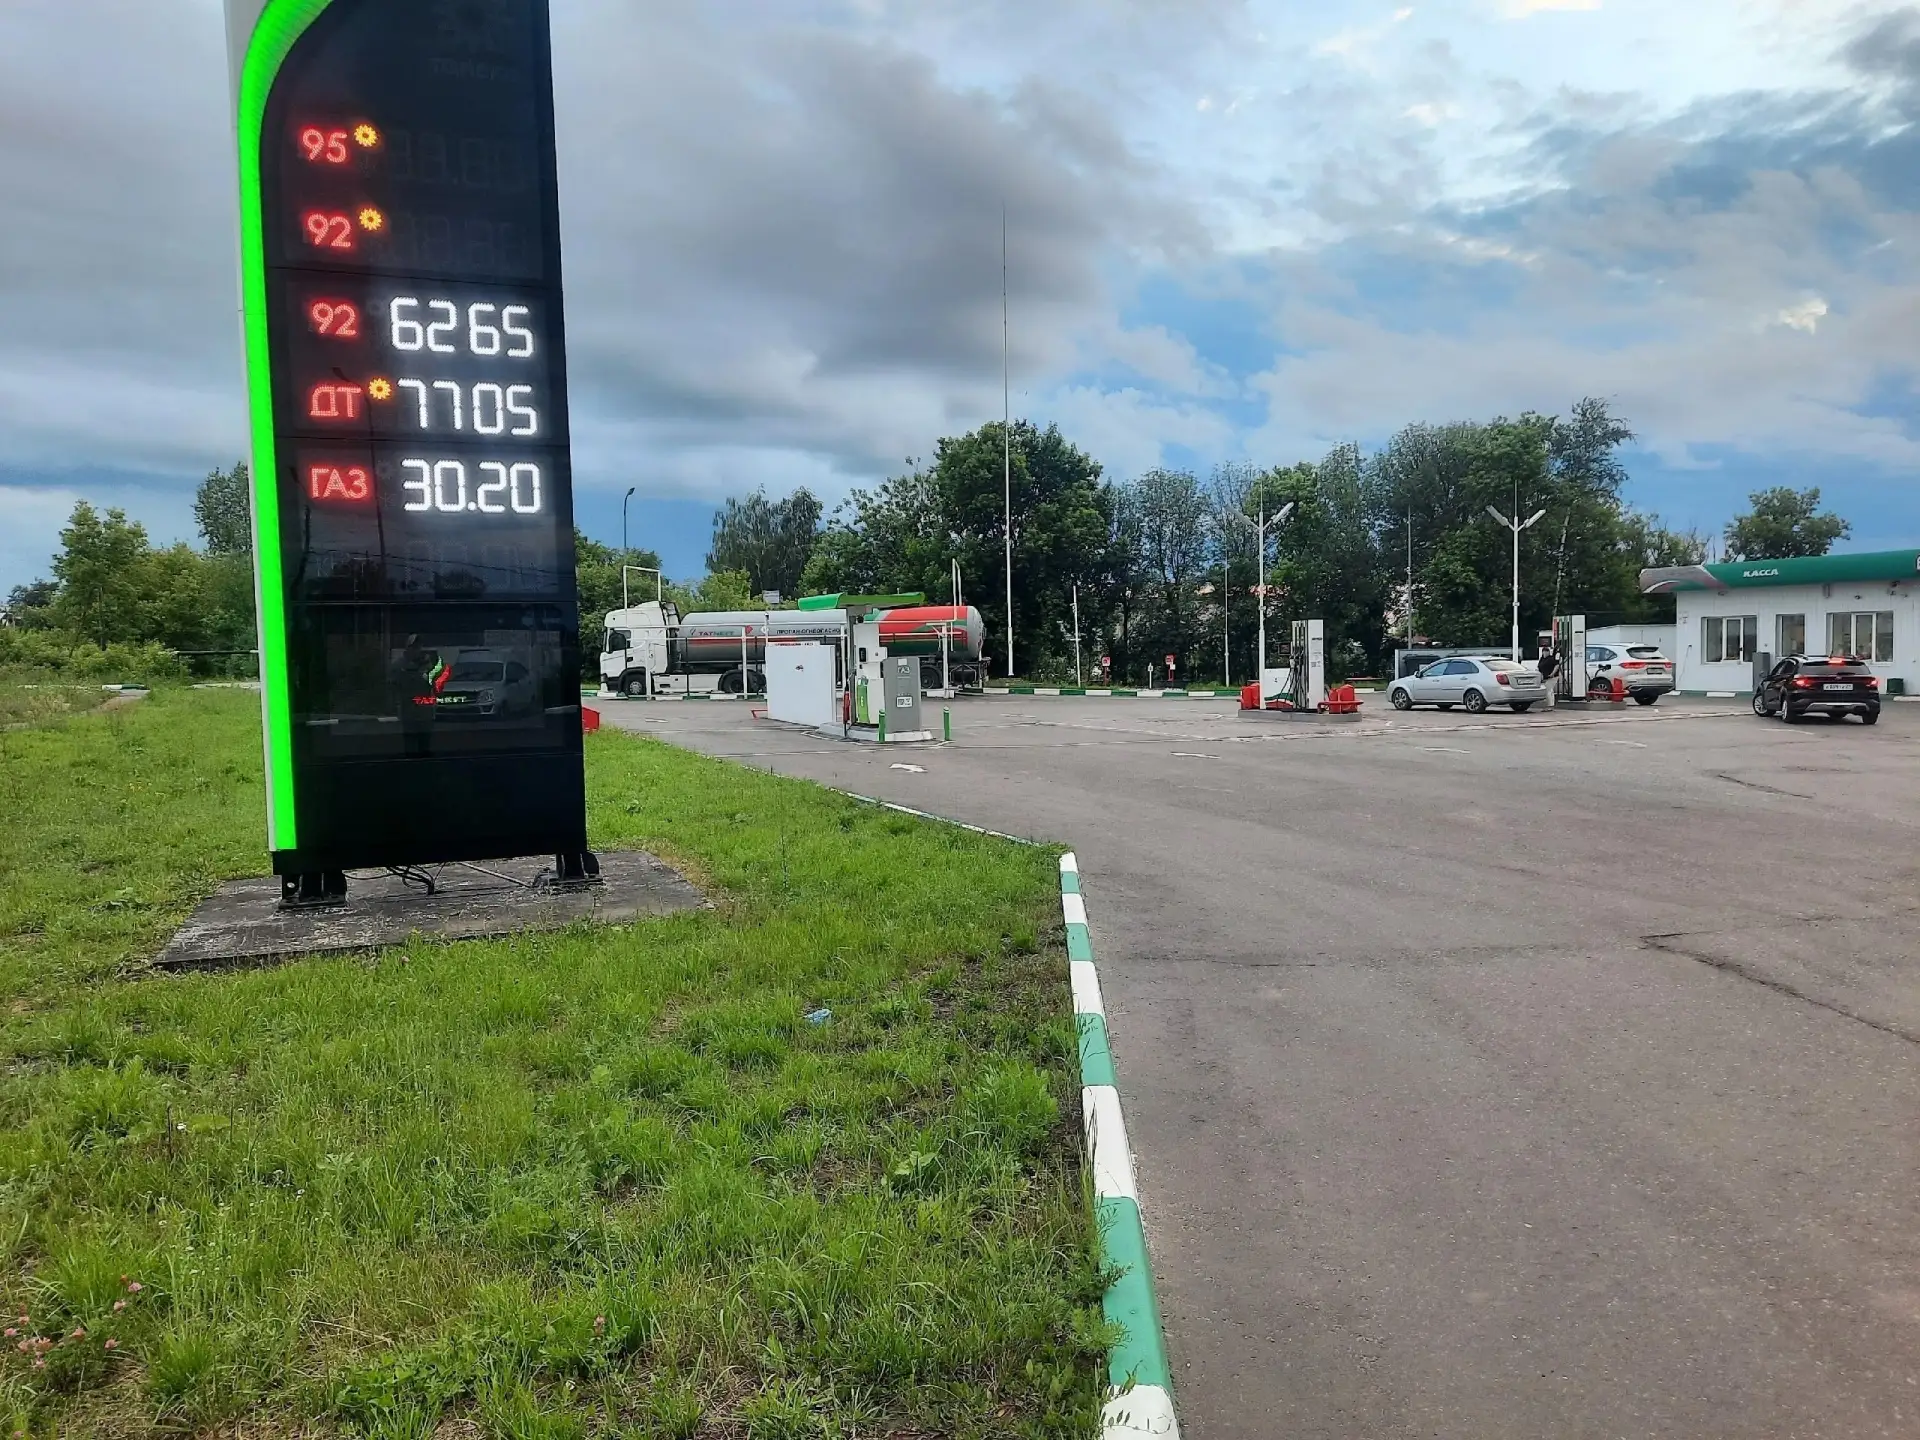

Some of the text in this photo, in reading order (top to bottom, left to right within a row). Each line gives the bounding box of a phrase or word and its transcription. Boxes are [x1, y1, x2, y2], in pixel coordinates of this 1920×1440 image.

[303, 128, 347, 163] 95
[308, 213, 351, 247] 92
[313, 302, 357, 335] 92
[310, 386, 362, 417] ДТ
[311, 458, 541, 513] ГАЗ 30.20
[1743, 568, 1779, 578] КАССА
